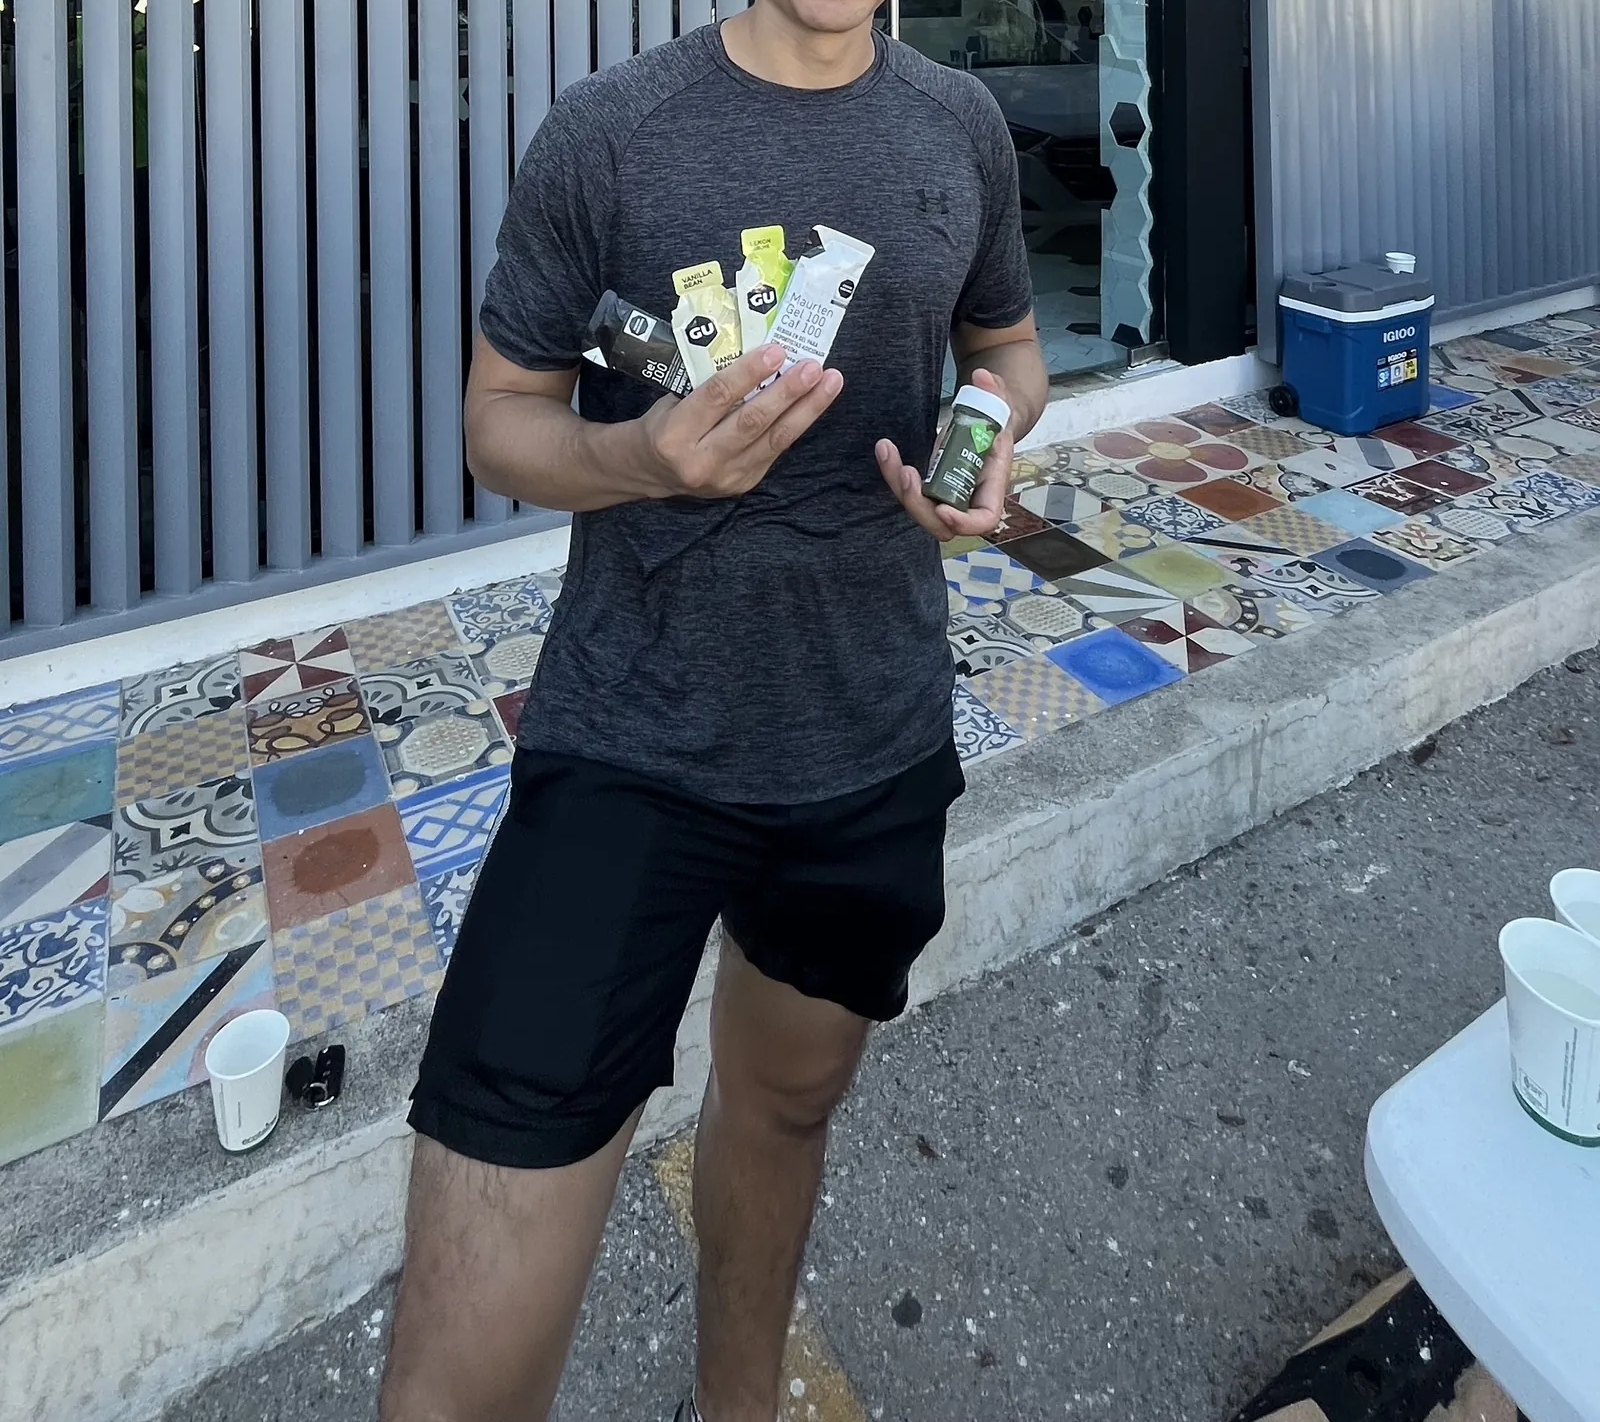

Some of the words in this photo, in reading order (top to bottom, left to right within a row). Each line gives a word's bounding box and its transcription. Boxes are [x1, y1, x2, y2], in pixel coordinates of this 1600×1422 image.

[681, 269, 713, 284] VANILLA
[683, 279, 703, 290] BEAN
[750, 291, 775, 306] GU
[790, 292, 834, 318] Maurten
[786, 303, 805, 319] Gel
[806, 311, 827, 328] 100
[689, 324, 715, 339] GU
[781, 314, 801, 330] Caf
[802, 323, 822, 339] 100
[1383, 326, 1415, 343] IGLOO
[713, 350, 743, 365] VANILLA
[641, 359, 658, 379] Gel
[651, 362, 668, 384] 100
